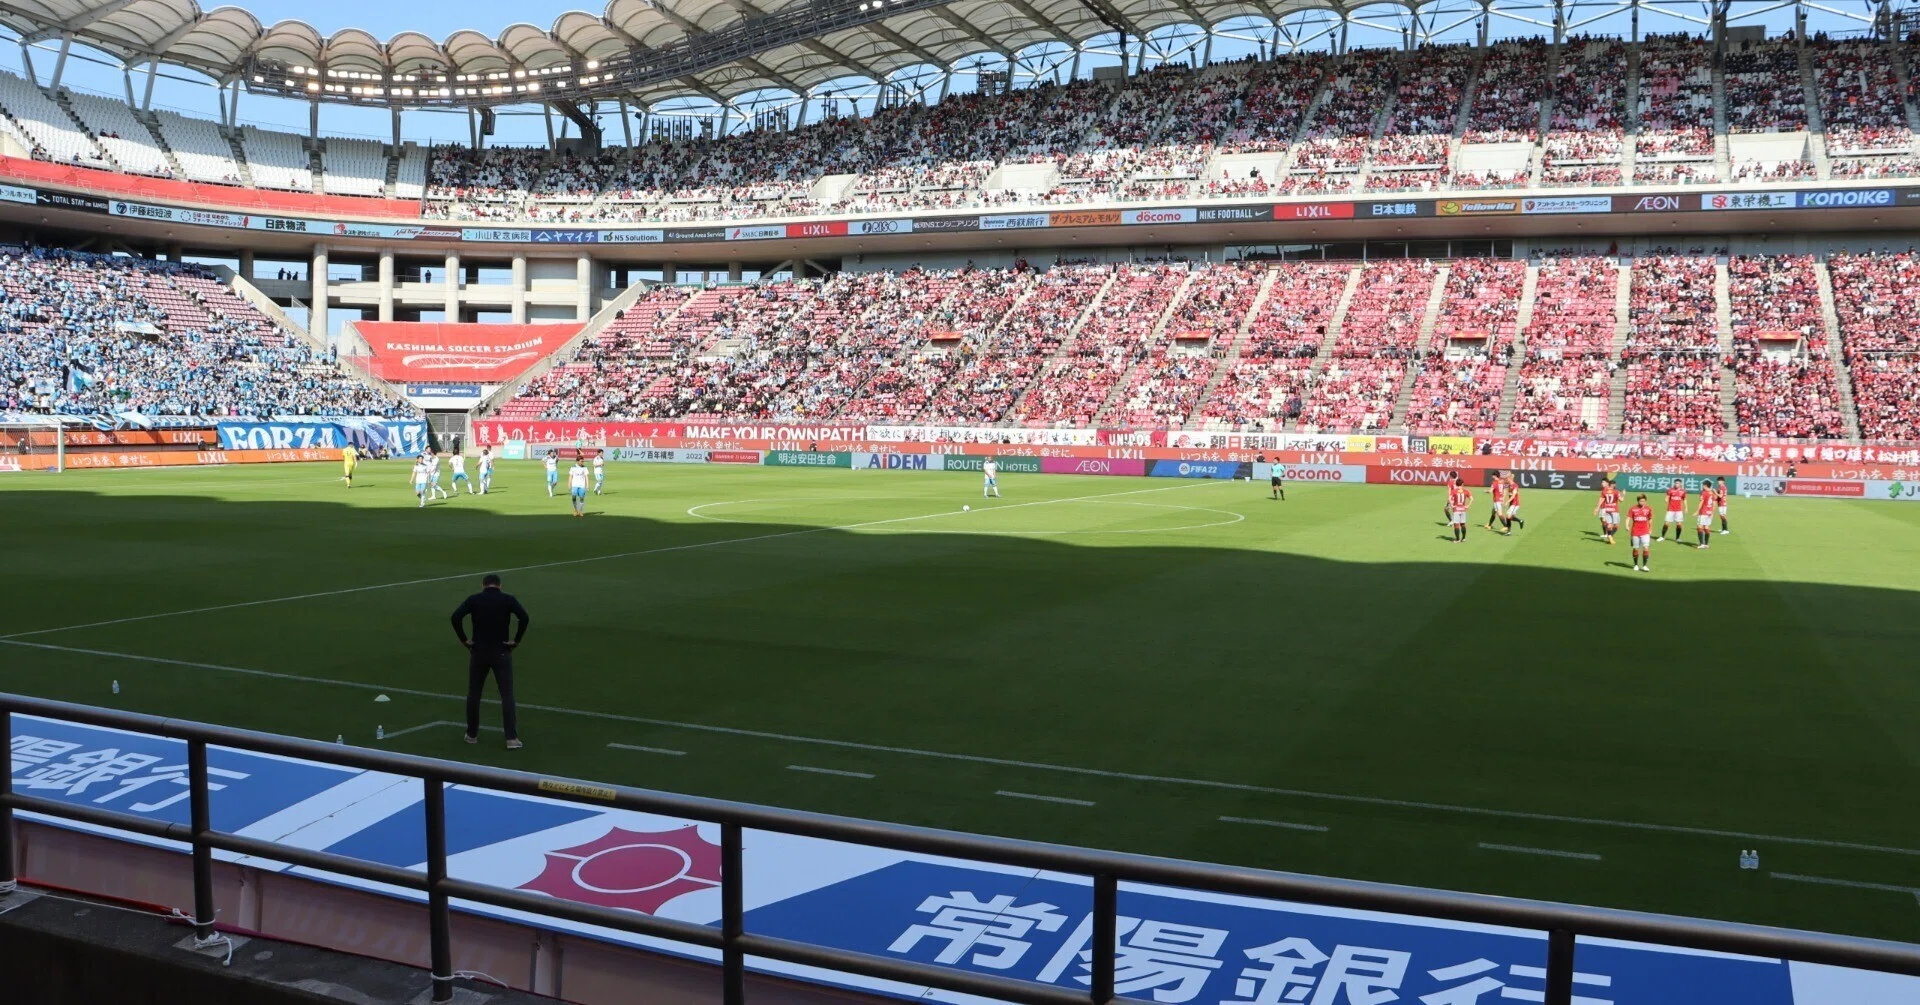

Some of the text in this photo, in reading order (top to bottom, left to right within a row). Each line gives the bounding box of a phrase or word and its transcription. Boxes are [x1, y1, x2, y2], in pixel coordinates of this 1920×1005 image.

[52, 195, 69, 205] TOTAL
[71, 198, 85, 206] STAY
[1199, 209, 1253, 220] NIKE FOOTBALL
[1296, 205, 1331, 218] LIXIL
[1372, 203, 1417, 215] 日本製鉄
[265, 218, 306, 231] 日鉄物流
[803, 225, 830, 235] LIXIL
[553, 231, 595, 243] ヤマイチ
[614, 233, 658, 242] NS Solutions
[386, 336, 543, 353] KASHIMA SOCCER STADIUM
[173, 431, 204, 443] LIXIL
[223, 426, 336, 450] FORZA
[686, 427, 732, 441] MAKE
[777, 427, 820, 441] OWN
[820, 427, 865, 441] PATH
[625, 439, 655, 448] LIXIL
[770, 442, 802, 451] LIXIL
[621, 449, 675, 461] Jリーグ百年構想
[930, 445, 966, 455] LIXIL
[1106, 449, 1145, 460] LIXIL
[197, 452, 229, 464] LIXIL
[778, 453, 836, 465] 明治安田生命
[1301, 454, 1343, 465] LIXIL
[947, 459, 981, 470] ROUTE
[1006, 463, 1038, 471] HOTELS
[1190, 465, 1207, 473] FIFA
[1208, 465, 1217, 473] 22
[1510, 459, 1555, 471] LIXIL
[1737, 464, 1788, 477] LIXIL
[1287, 469, 1342, 480] ocomo
[1520, 472, 1593, 489] いちご
[1743, 482, 1770, 491] 2022
